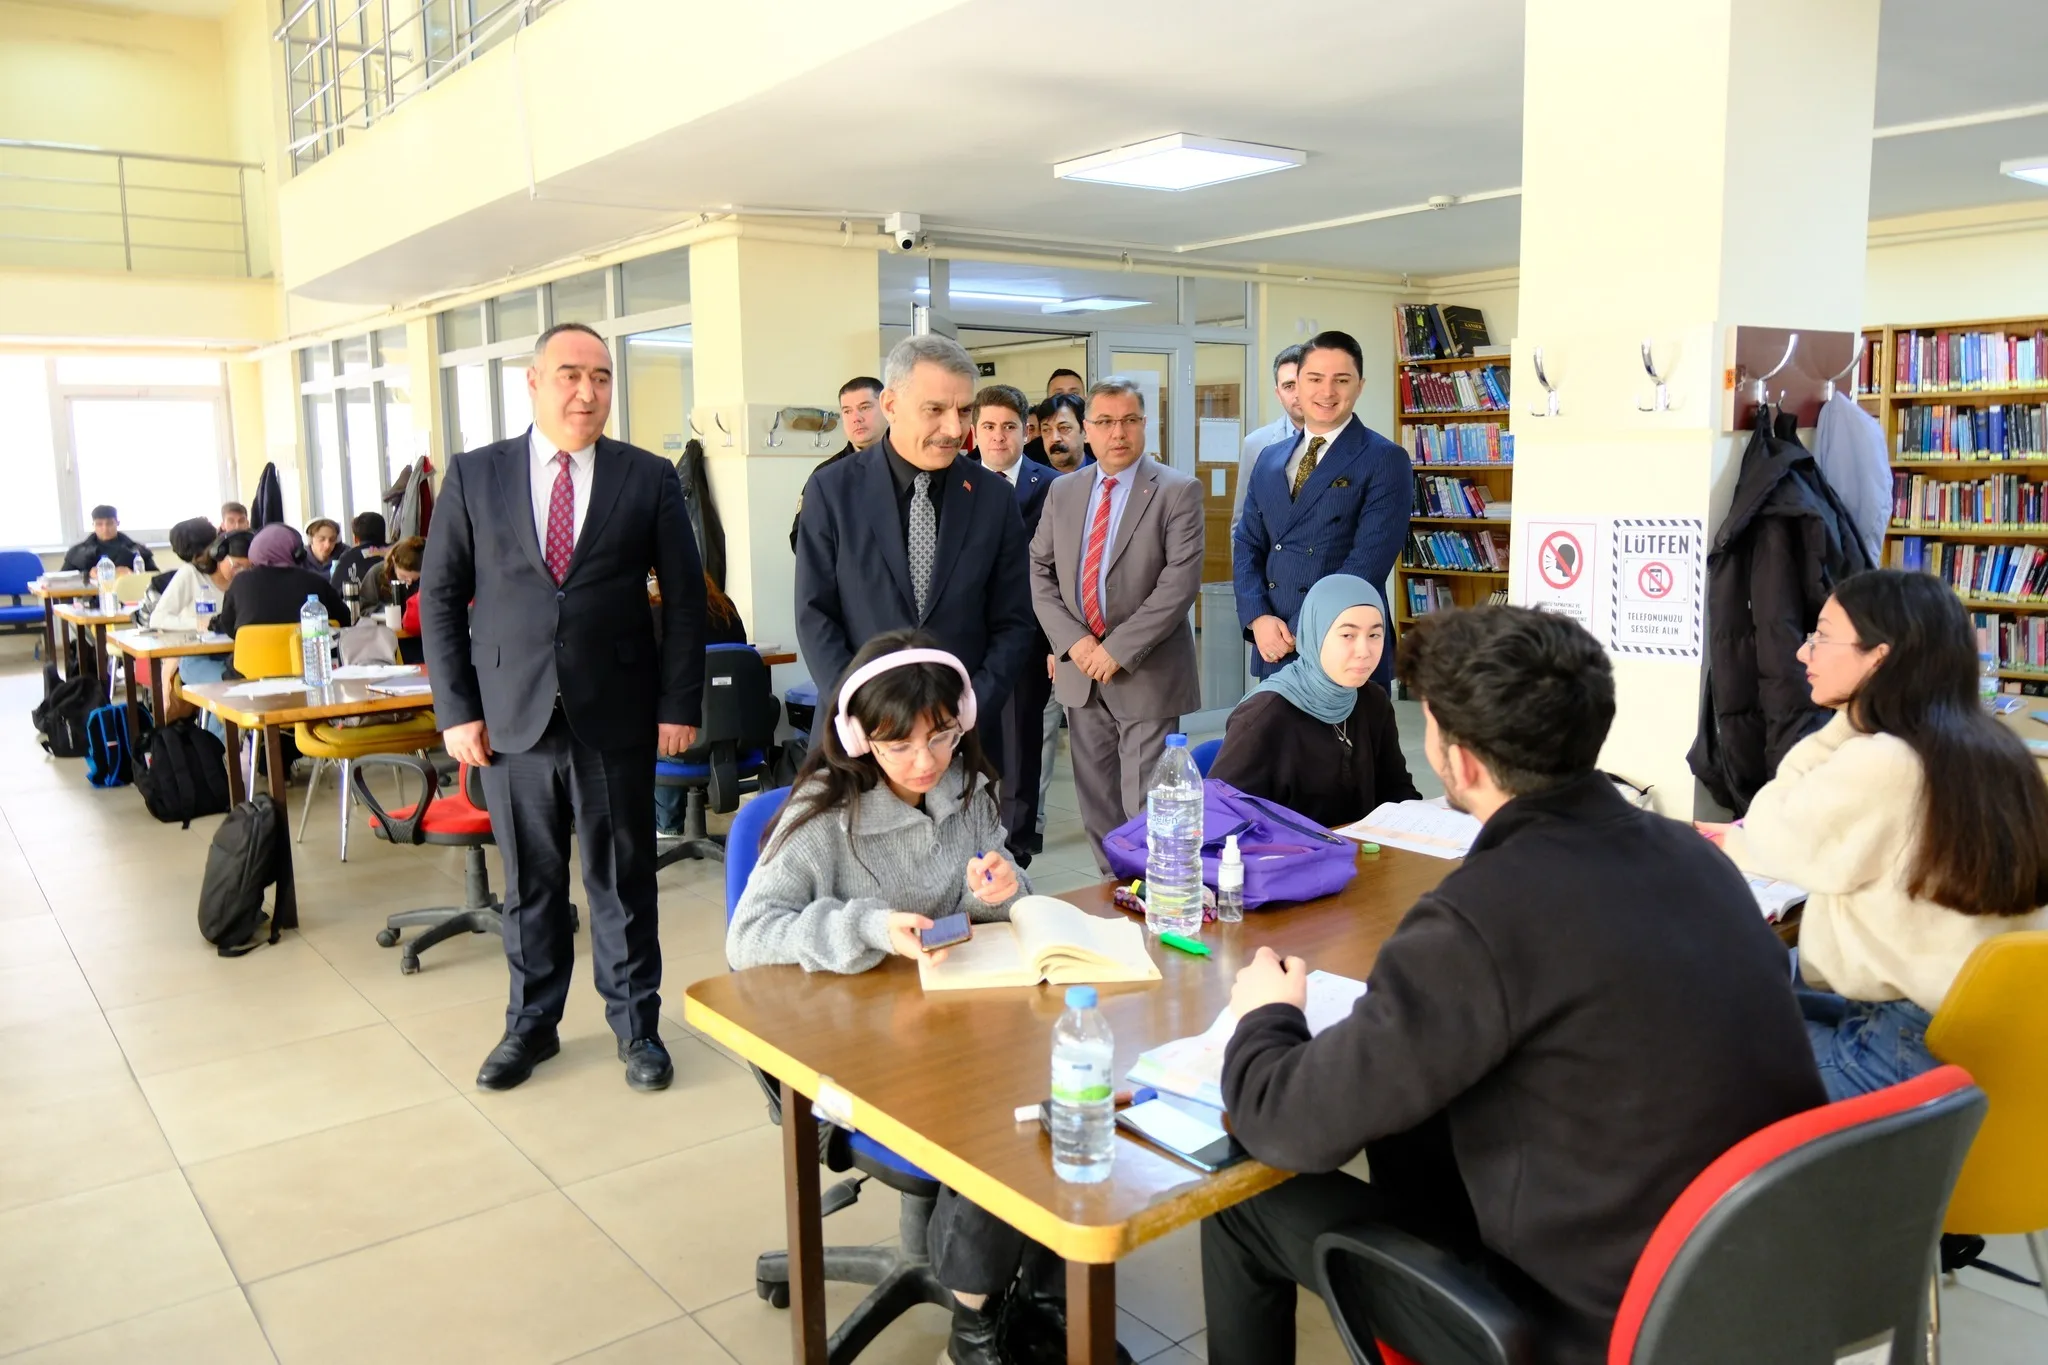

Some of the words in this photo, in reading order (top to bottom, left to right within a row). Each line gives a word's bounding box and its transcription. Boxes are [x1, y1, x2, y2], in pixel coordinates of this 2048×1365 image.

[1624, 534, 1689, 554] LÜTFEN
[1628, 612, 1682, 623] TELEFONUNUZU
[1631, 624, 1659, 634] SESSİZE
[1662, 626, 1679, 635] ALIN
